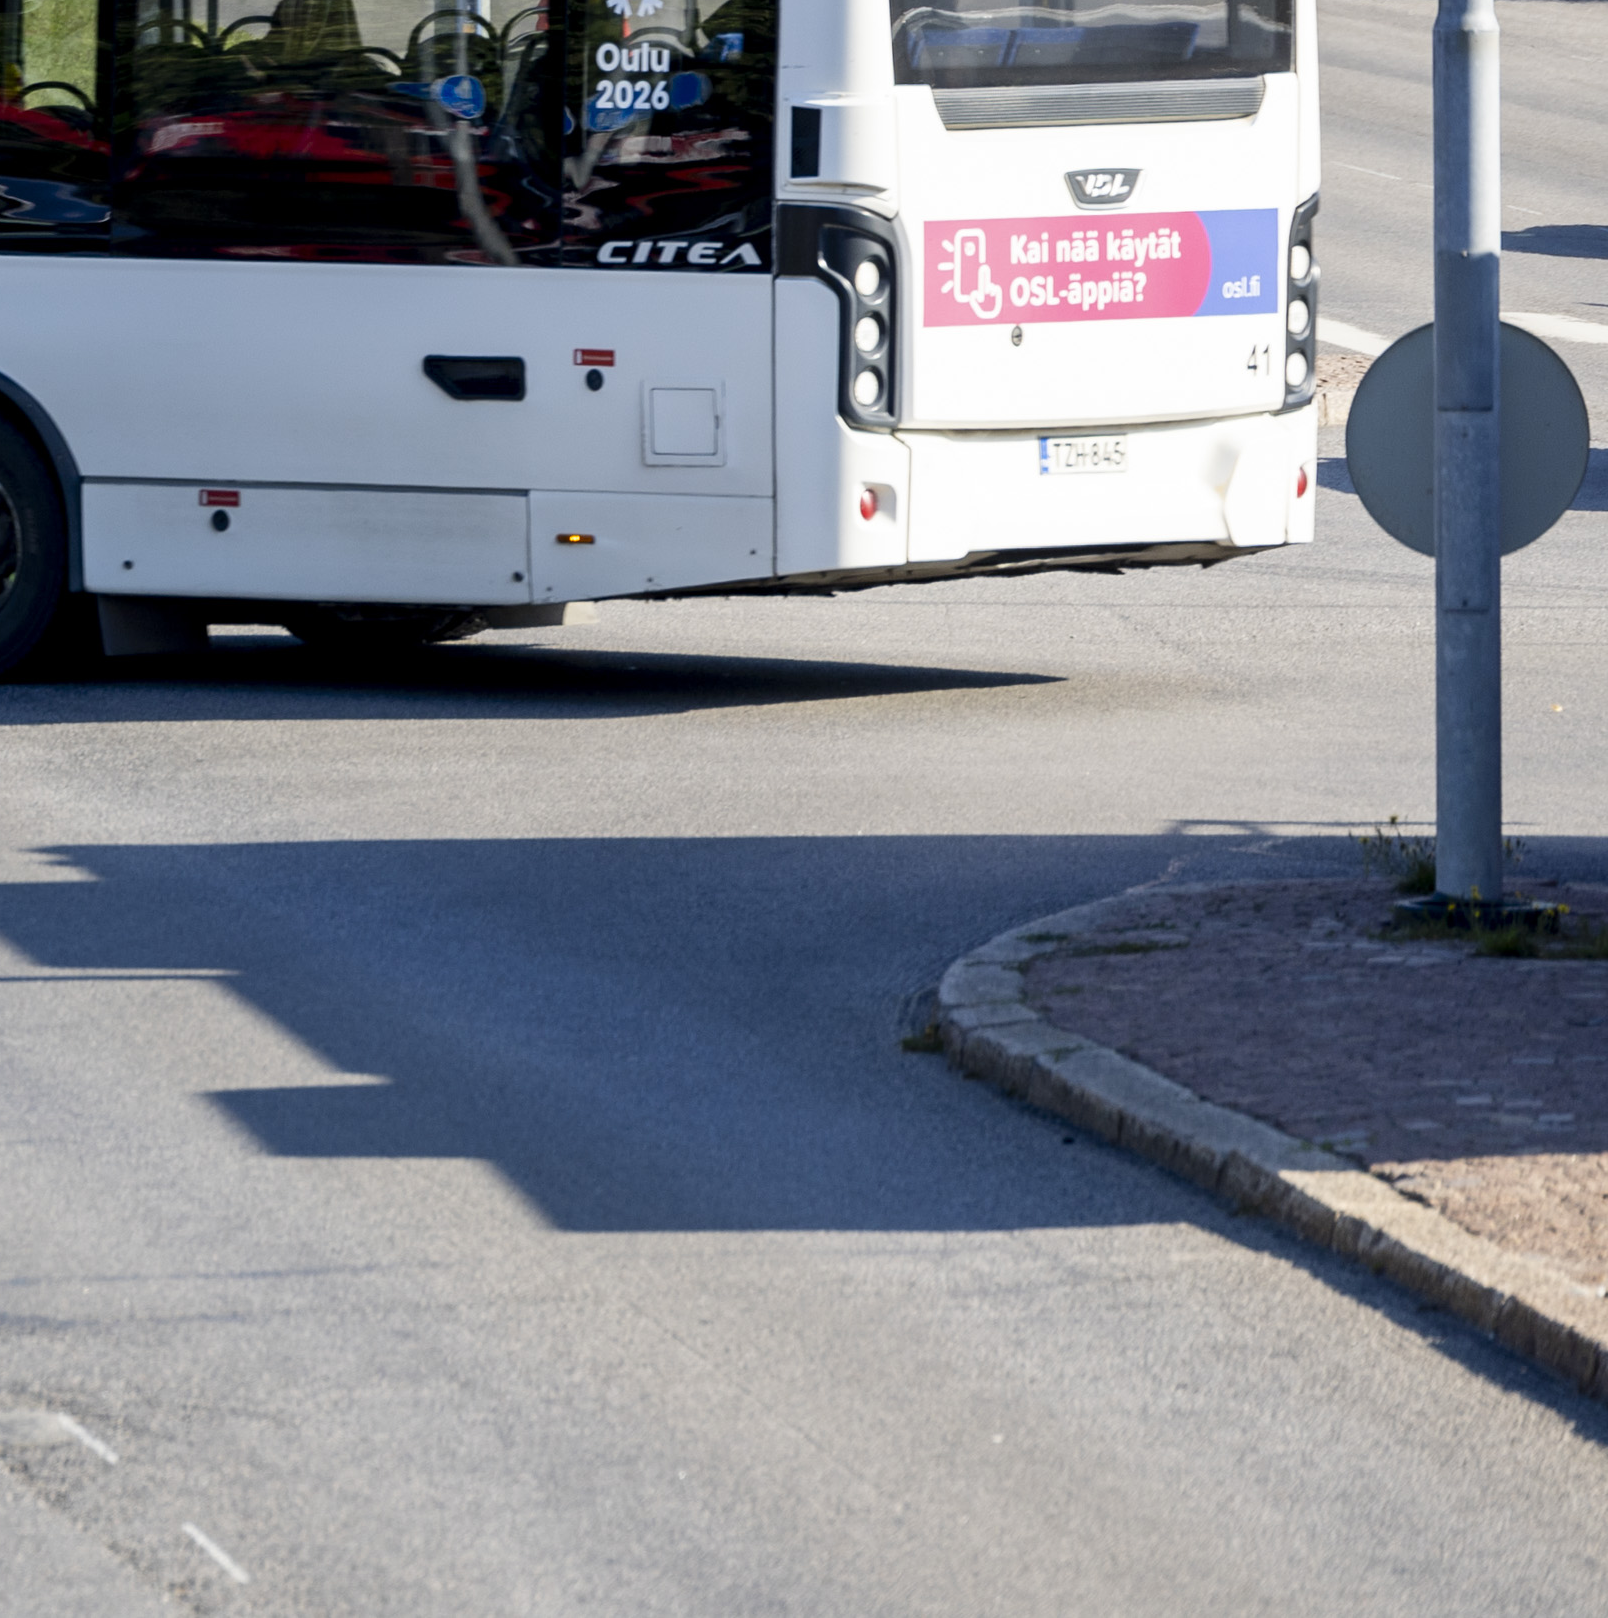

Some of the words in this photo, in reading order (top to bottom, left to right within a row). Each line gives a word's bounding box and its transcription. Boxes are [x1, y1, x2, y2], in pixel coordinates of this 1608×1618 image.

[596, 42, 670, 72] Oulu
[595, 81, 670, 110] 2026
[1075, 173, 1130, 197] VDL
[597, 240, 762, 265] CITEA
[1009, 234, 1049, 265] Kai
[1055, 231, 1100, 263] nää
[1106, 227, 1182, 267] käytät
[1009, 272, 1147, 312] OSL-äppiä?
[1222, 276, 1261, 301] osl.fi
[1246, 345, 1272, 377] 41
[1053, 441, 1125, 468] TZH-845
